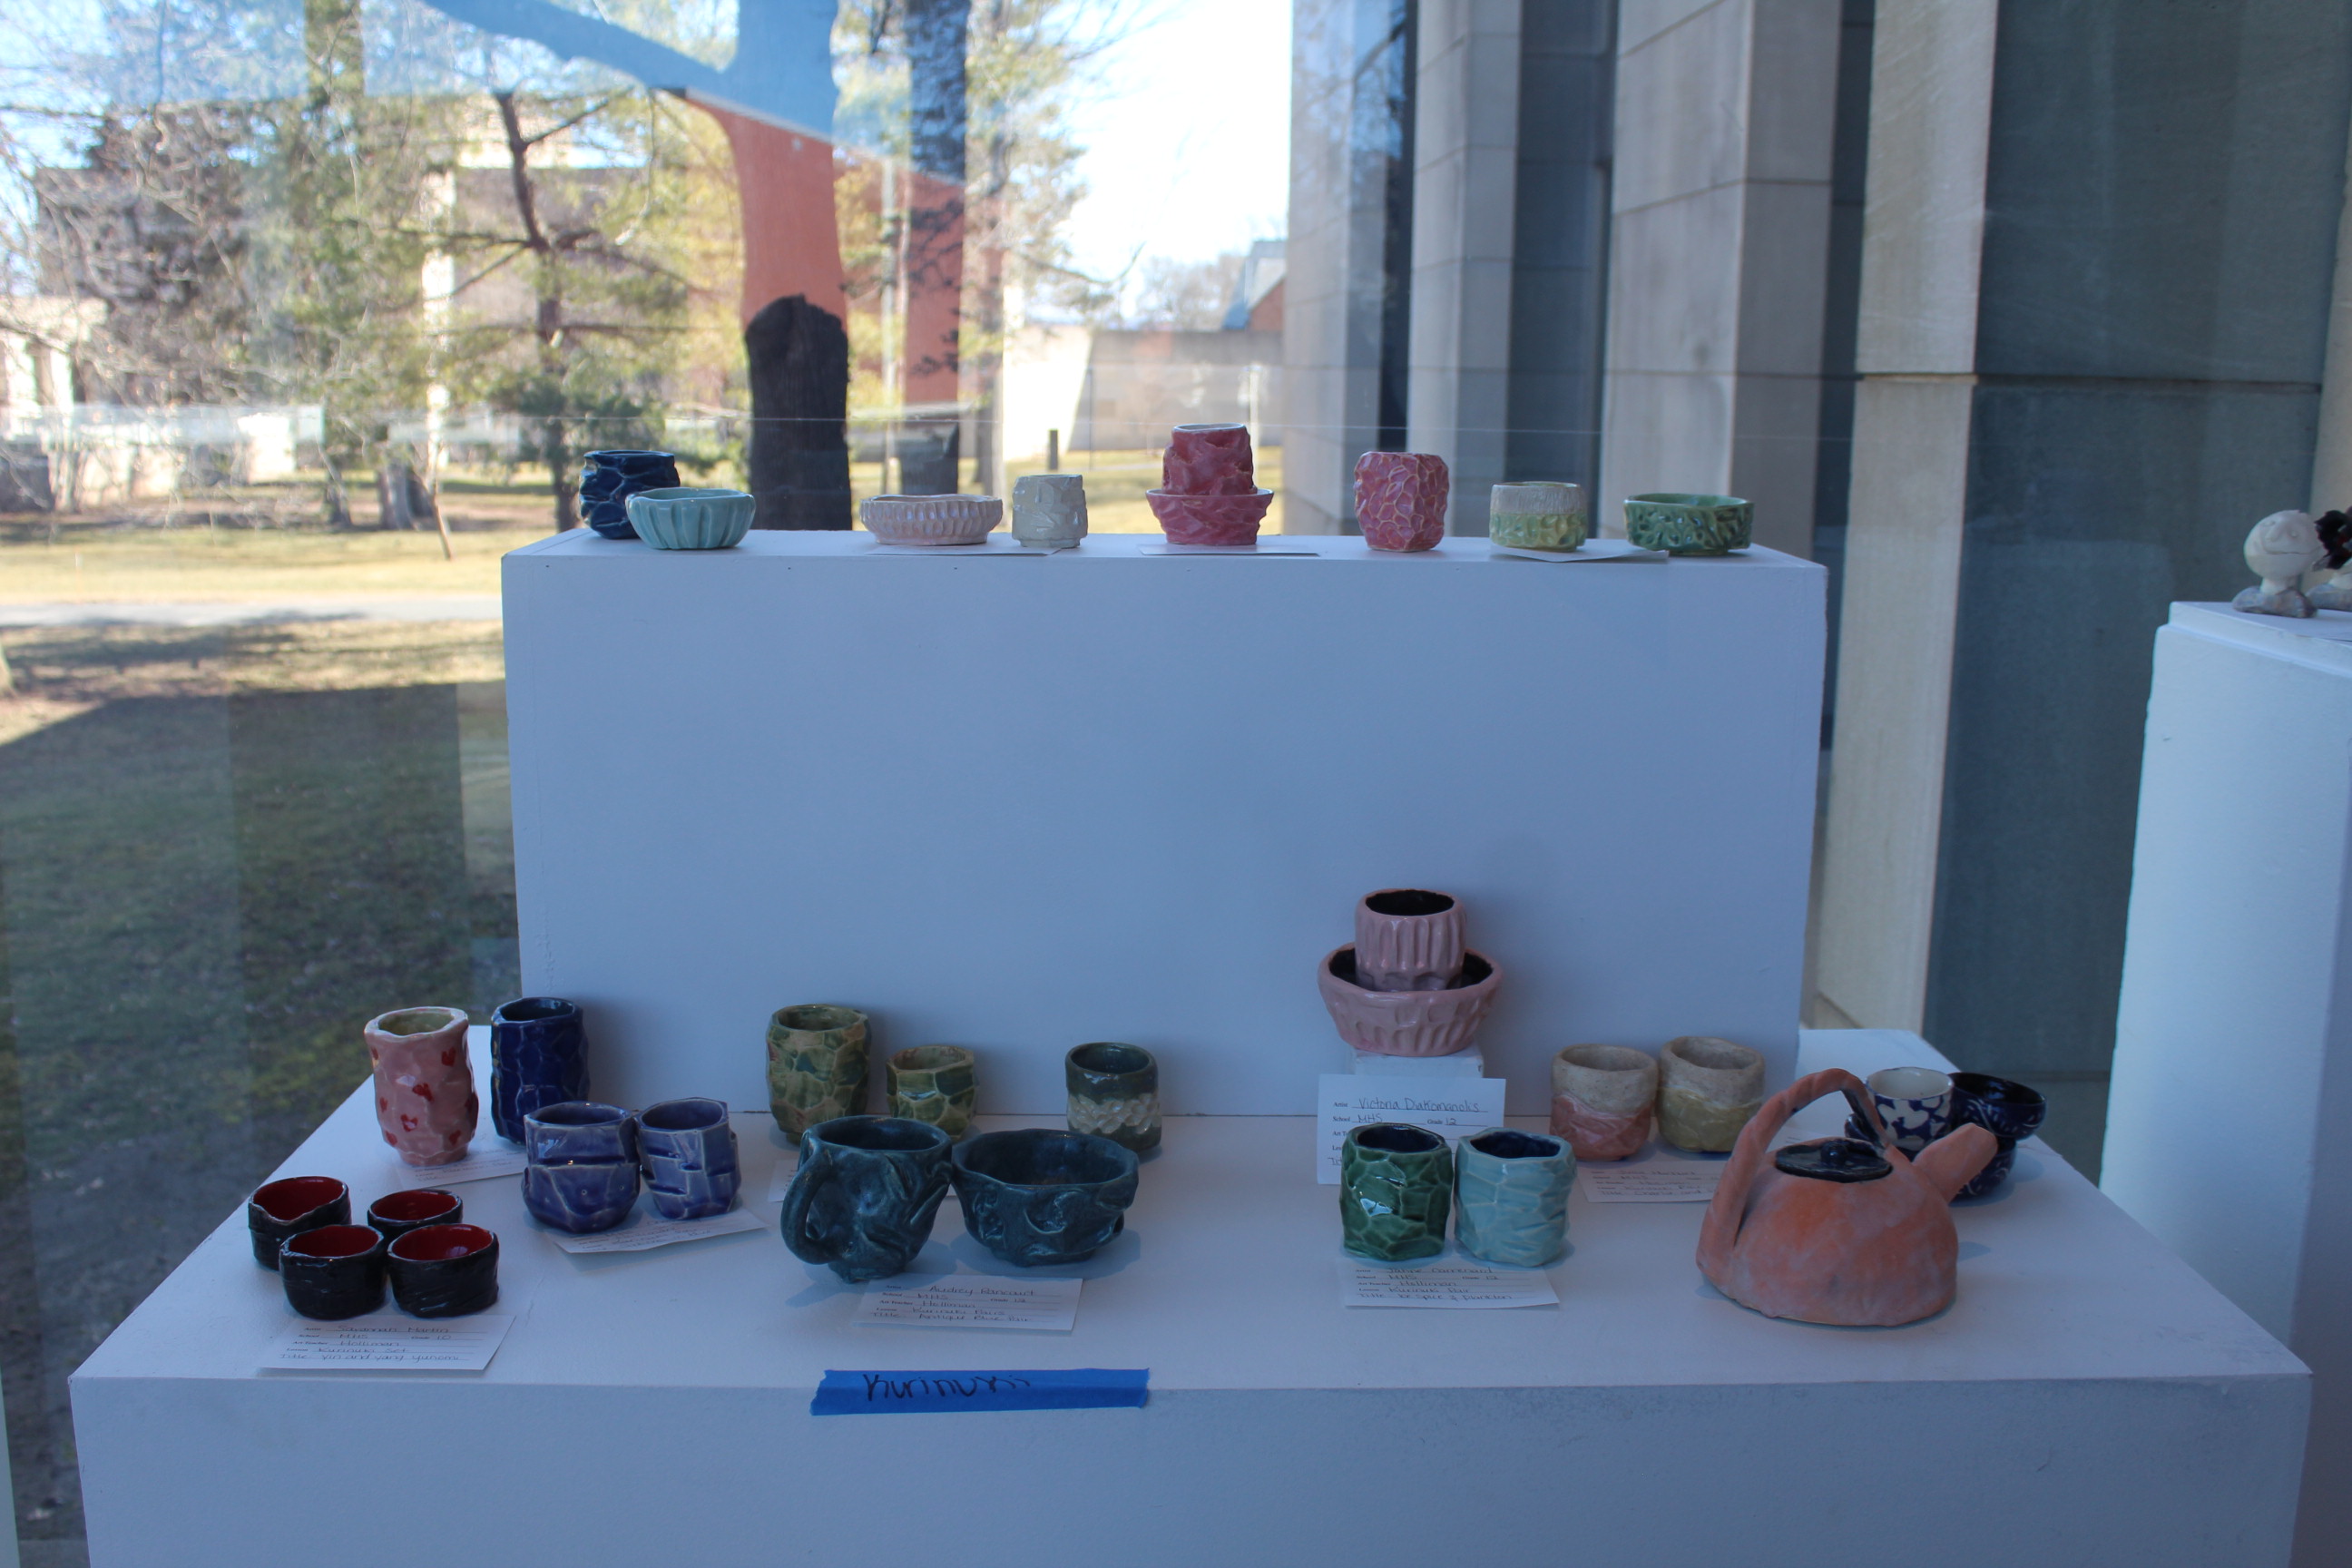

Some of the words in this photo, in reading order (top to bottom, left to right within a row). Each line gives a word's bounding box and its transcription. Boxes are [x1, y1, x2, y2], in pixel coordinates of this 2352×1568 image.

[1358, 1097, 1398, 1110] Victoria
[1357, 1112, 1383, 1122] MHS
[1446, 1117, 1457, 1126] 12
[929, 1285, 974, 1297] Audrey
[980, 1287, 1034, 1296] Rancourt
